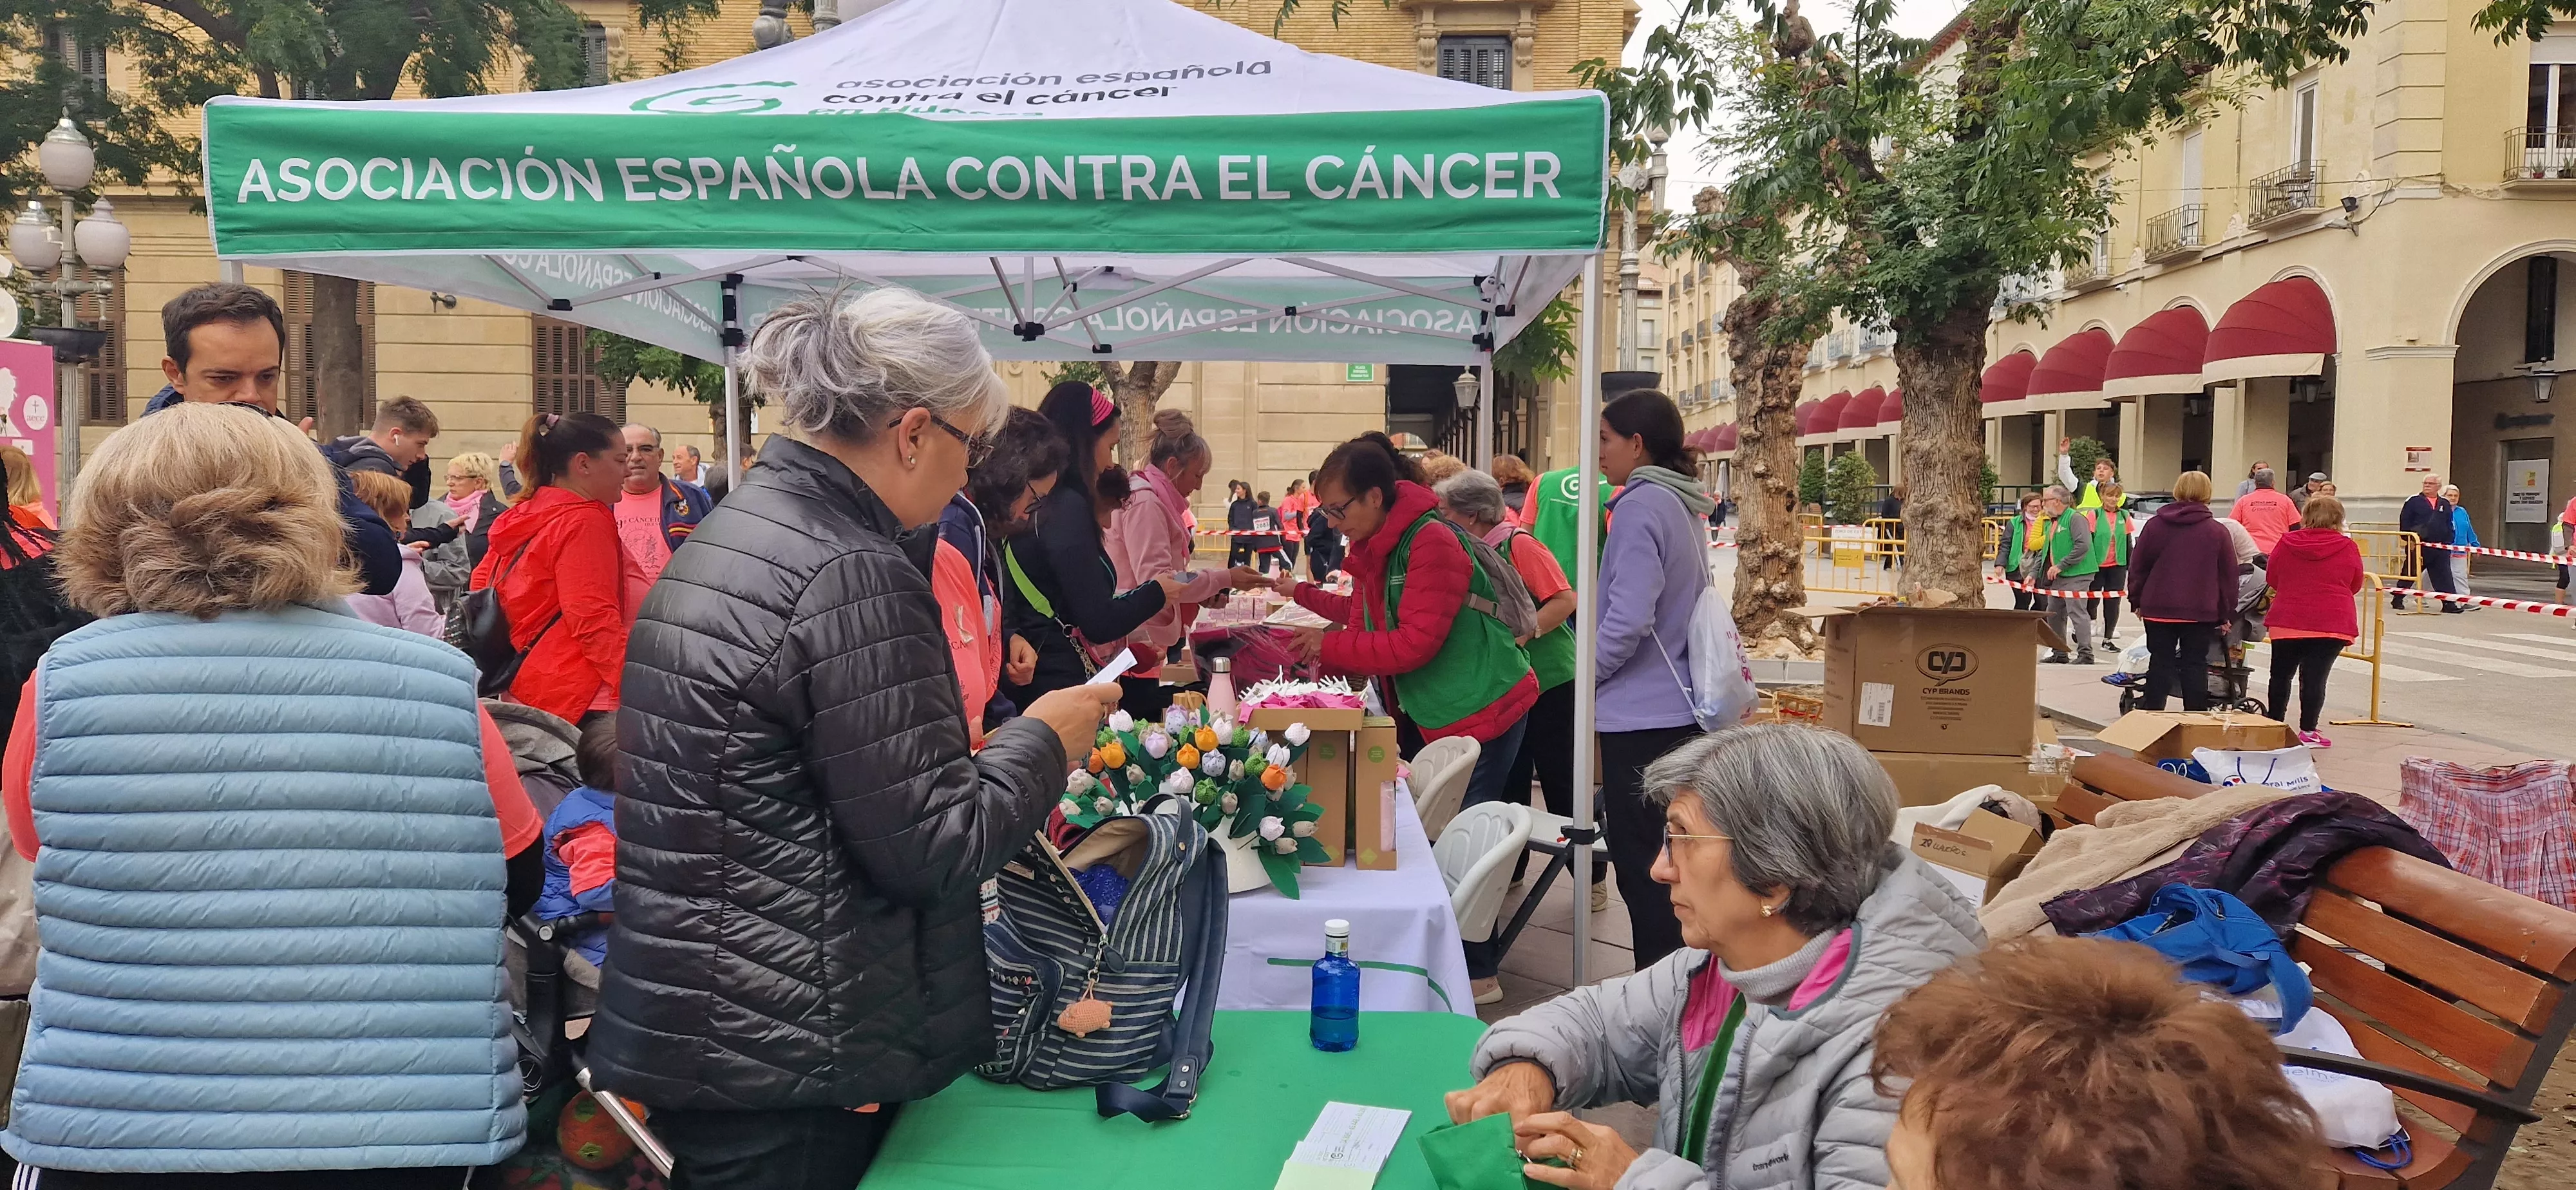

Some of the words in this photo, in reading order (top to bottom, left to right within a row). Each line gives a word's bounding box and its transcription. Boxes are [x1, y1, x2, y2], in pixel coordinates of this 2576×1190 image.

[837, 73, 1061, 89] asociación
[1076, 60, 1271, 85] española
[822, 91, 962, 104] contra
[976, 90, 1014, 106] el
[1026, 85, 1177, 106] cáncer
[237, 146, 603, 203] ASOCIACIÓN
[615, 144, 935, 201] ESPAÑOLA
[947, 155, 1202, 200] CONTRA
[1219, 155, 1291, 200] EL
[1305, 146, 1560, 200] CÁNCER
[2287, 775, 2309, 788] Mills
